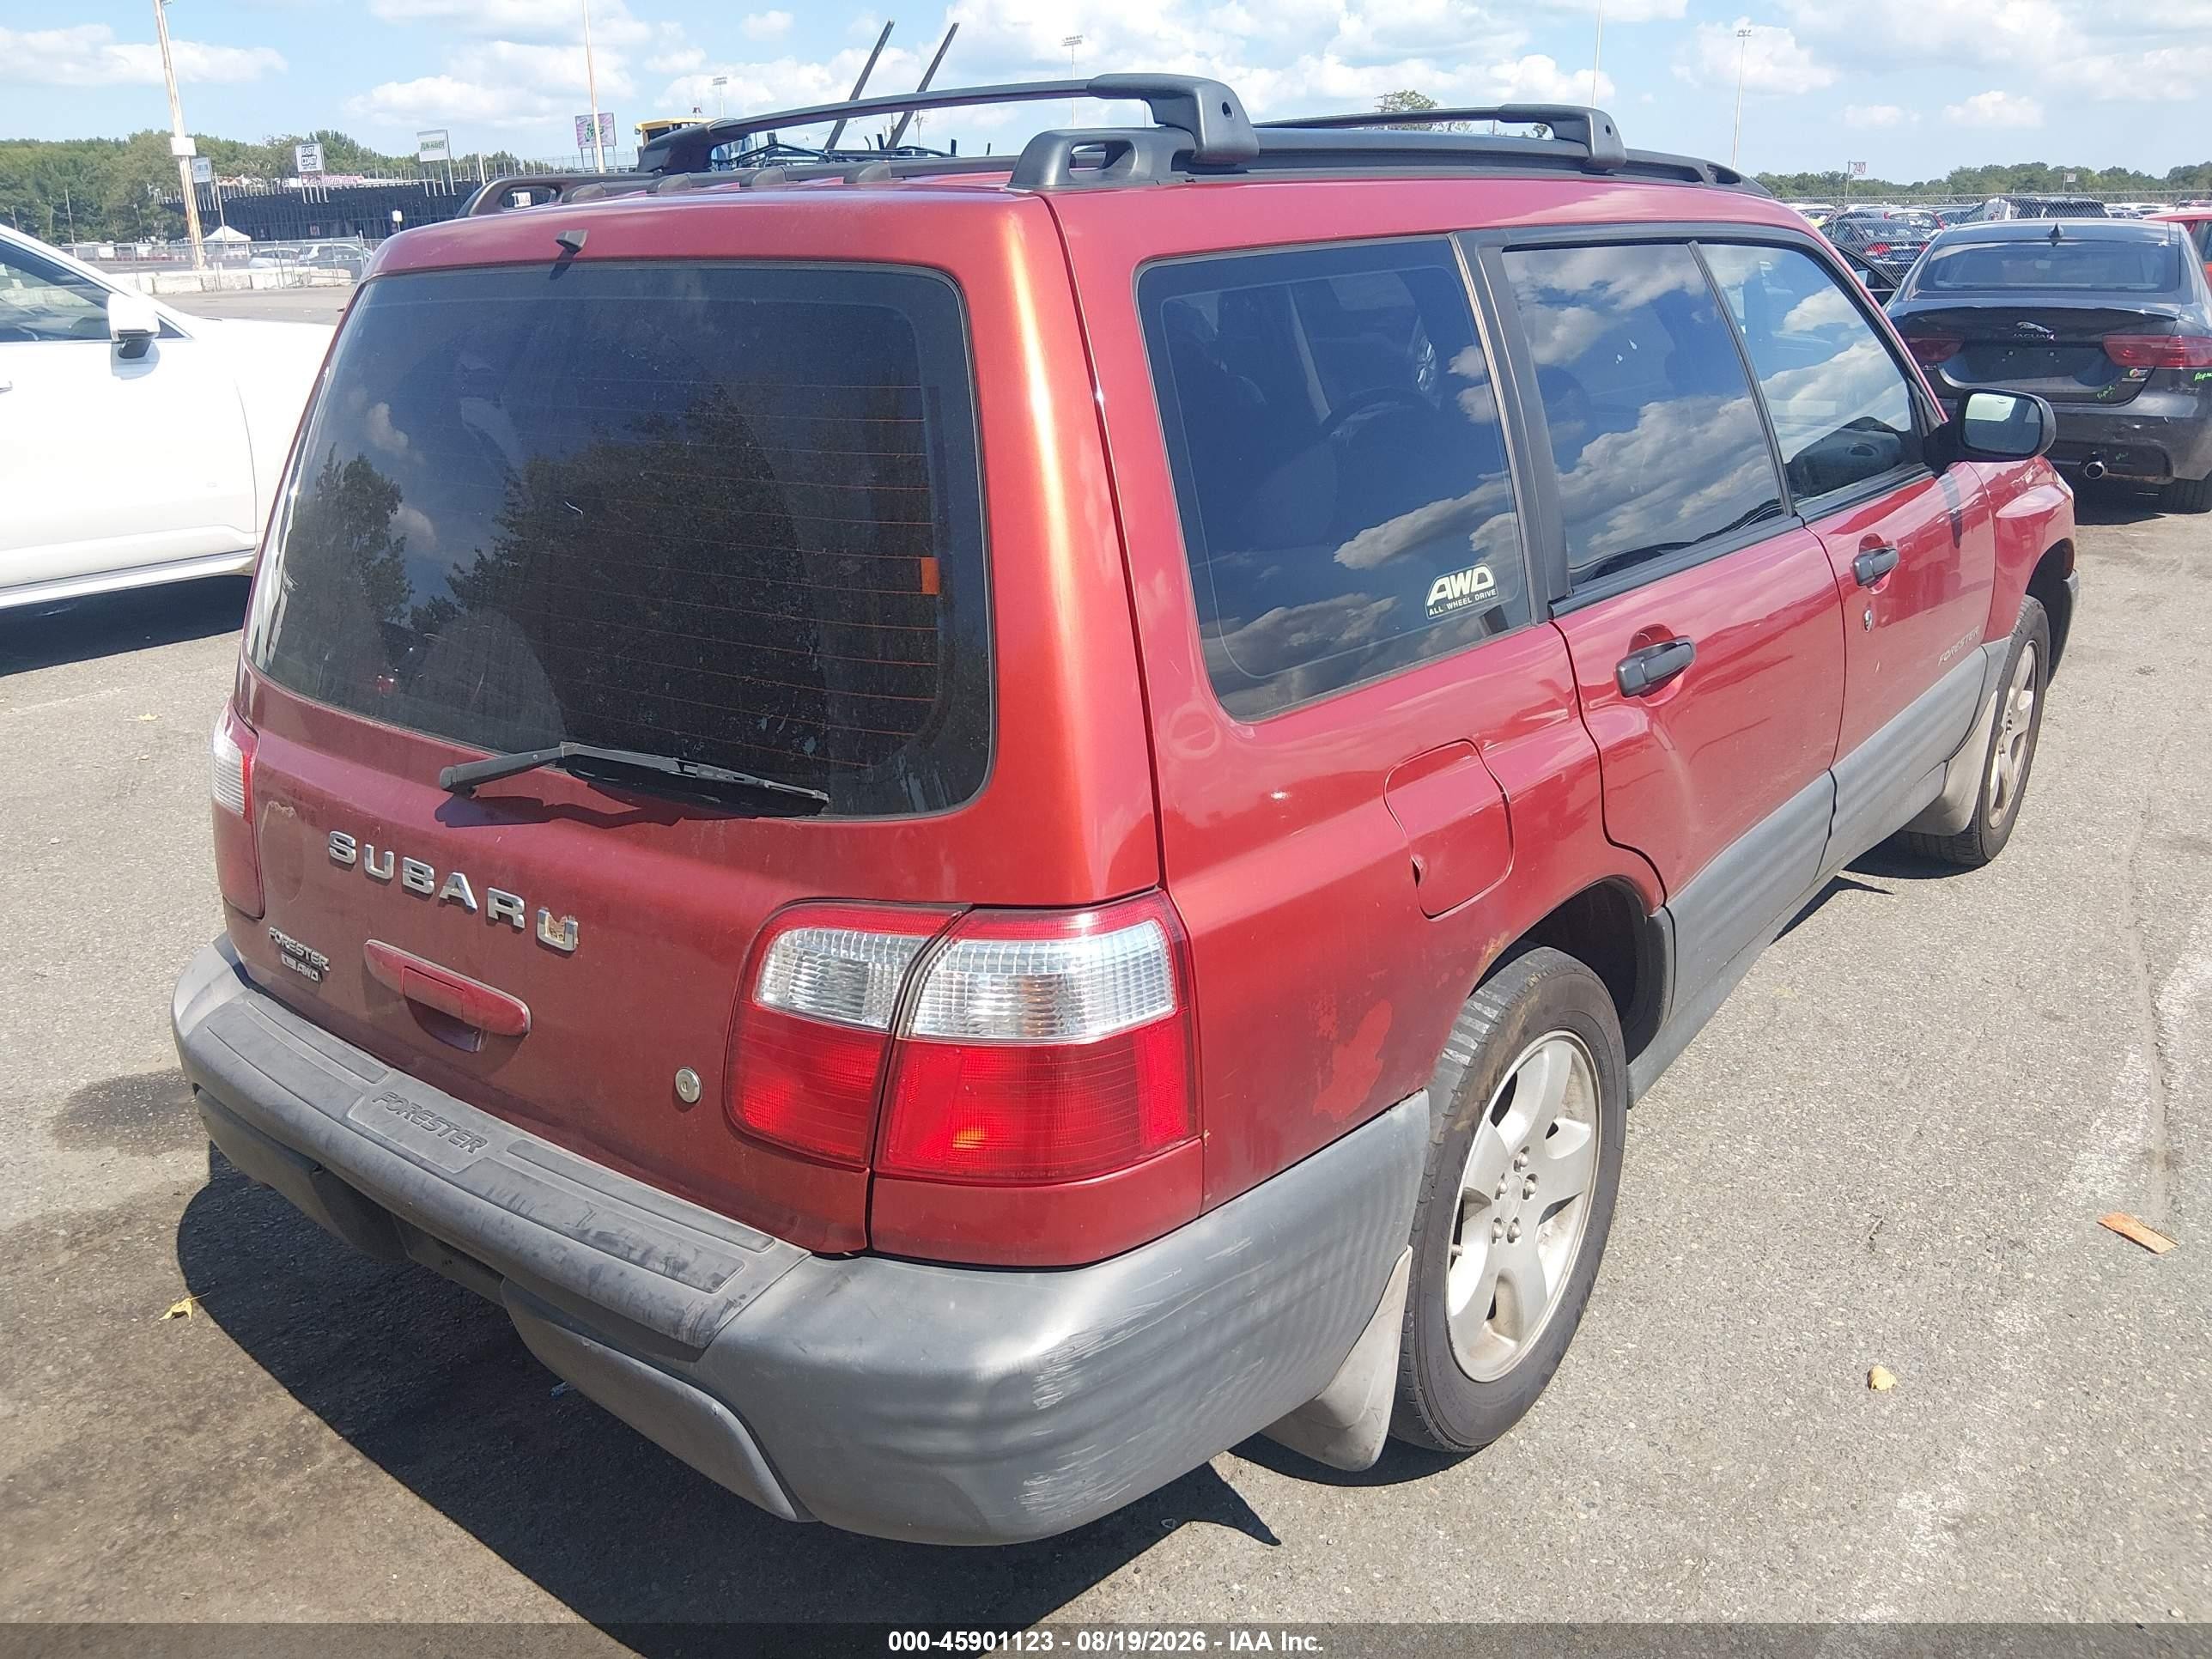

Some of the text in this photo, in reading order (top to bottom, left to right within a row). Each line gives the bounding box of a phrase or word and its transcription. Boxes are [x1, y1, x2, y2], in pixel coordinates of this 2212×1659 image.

[301, 145, 314, 156] EAST
[301, 155, 318, 166] COAST
[1852, 162, 1867, 173] 240
[1427, 566, 1495, 606] AWD
[1429, 588, 1497, 616] ALL WHEEL DRIVE
[1937, 625, 1981, 667] FORESTER
[328, 830, 580, 953] SUBARU
[268, 927, 331, 971] FORESTER
[296, 963, 319, 982] AWD
[372, 1091, 489, 1154] FORESTER
